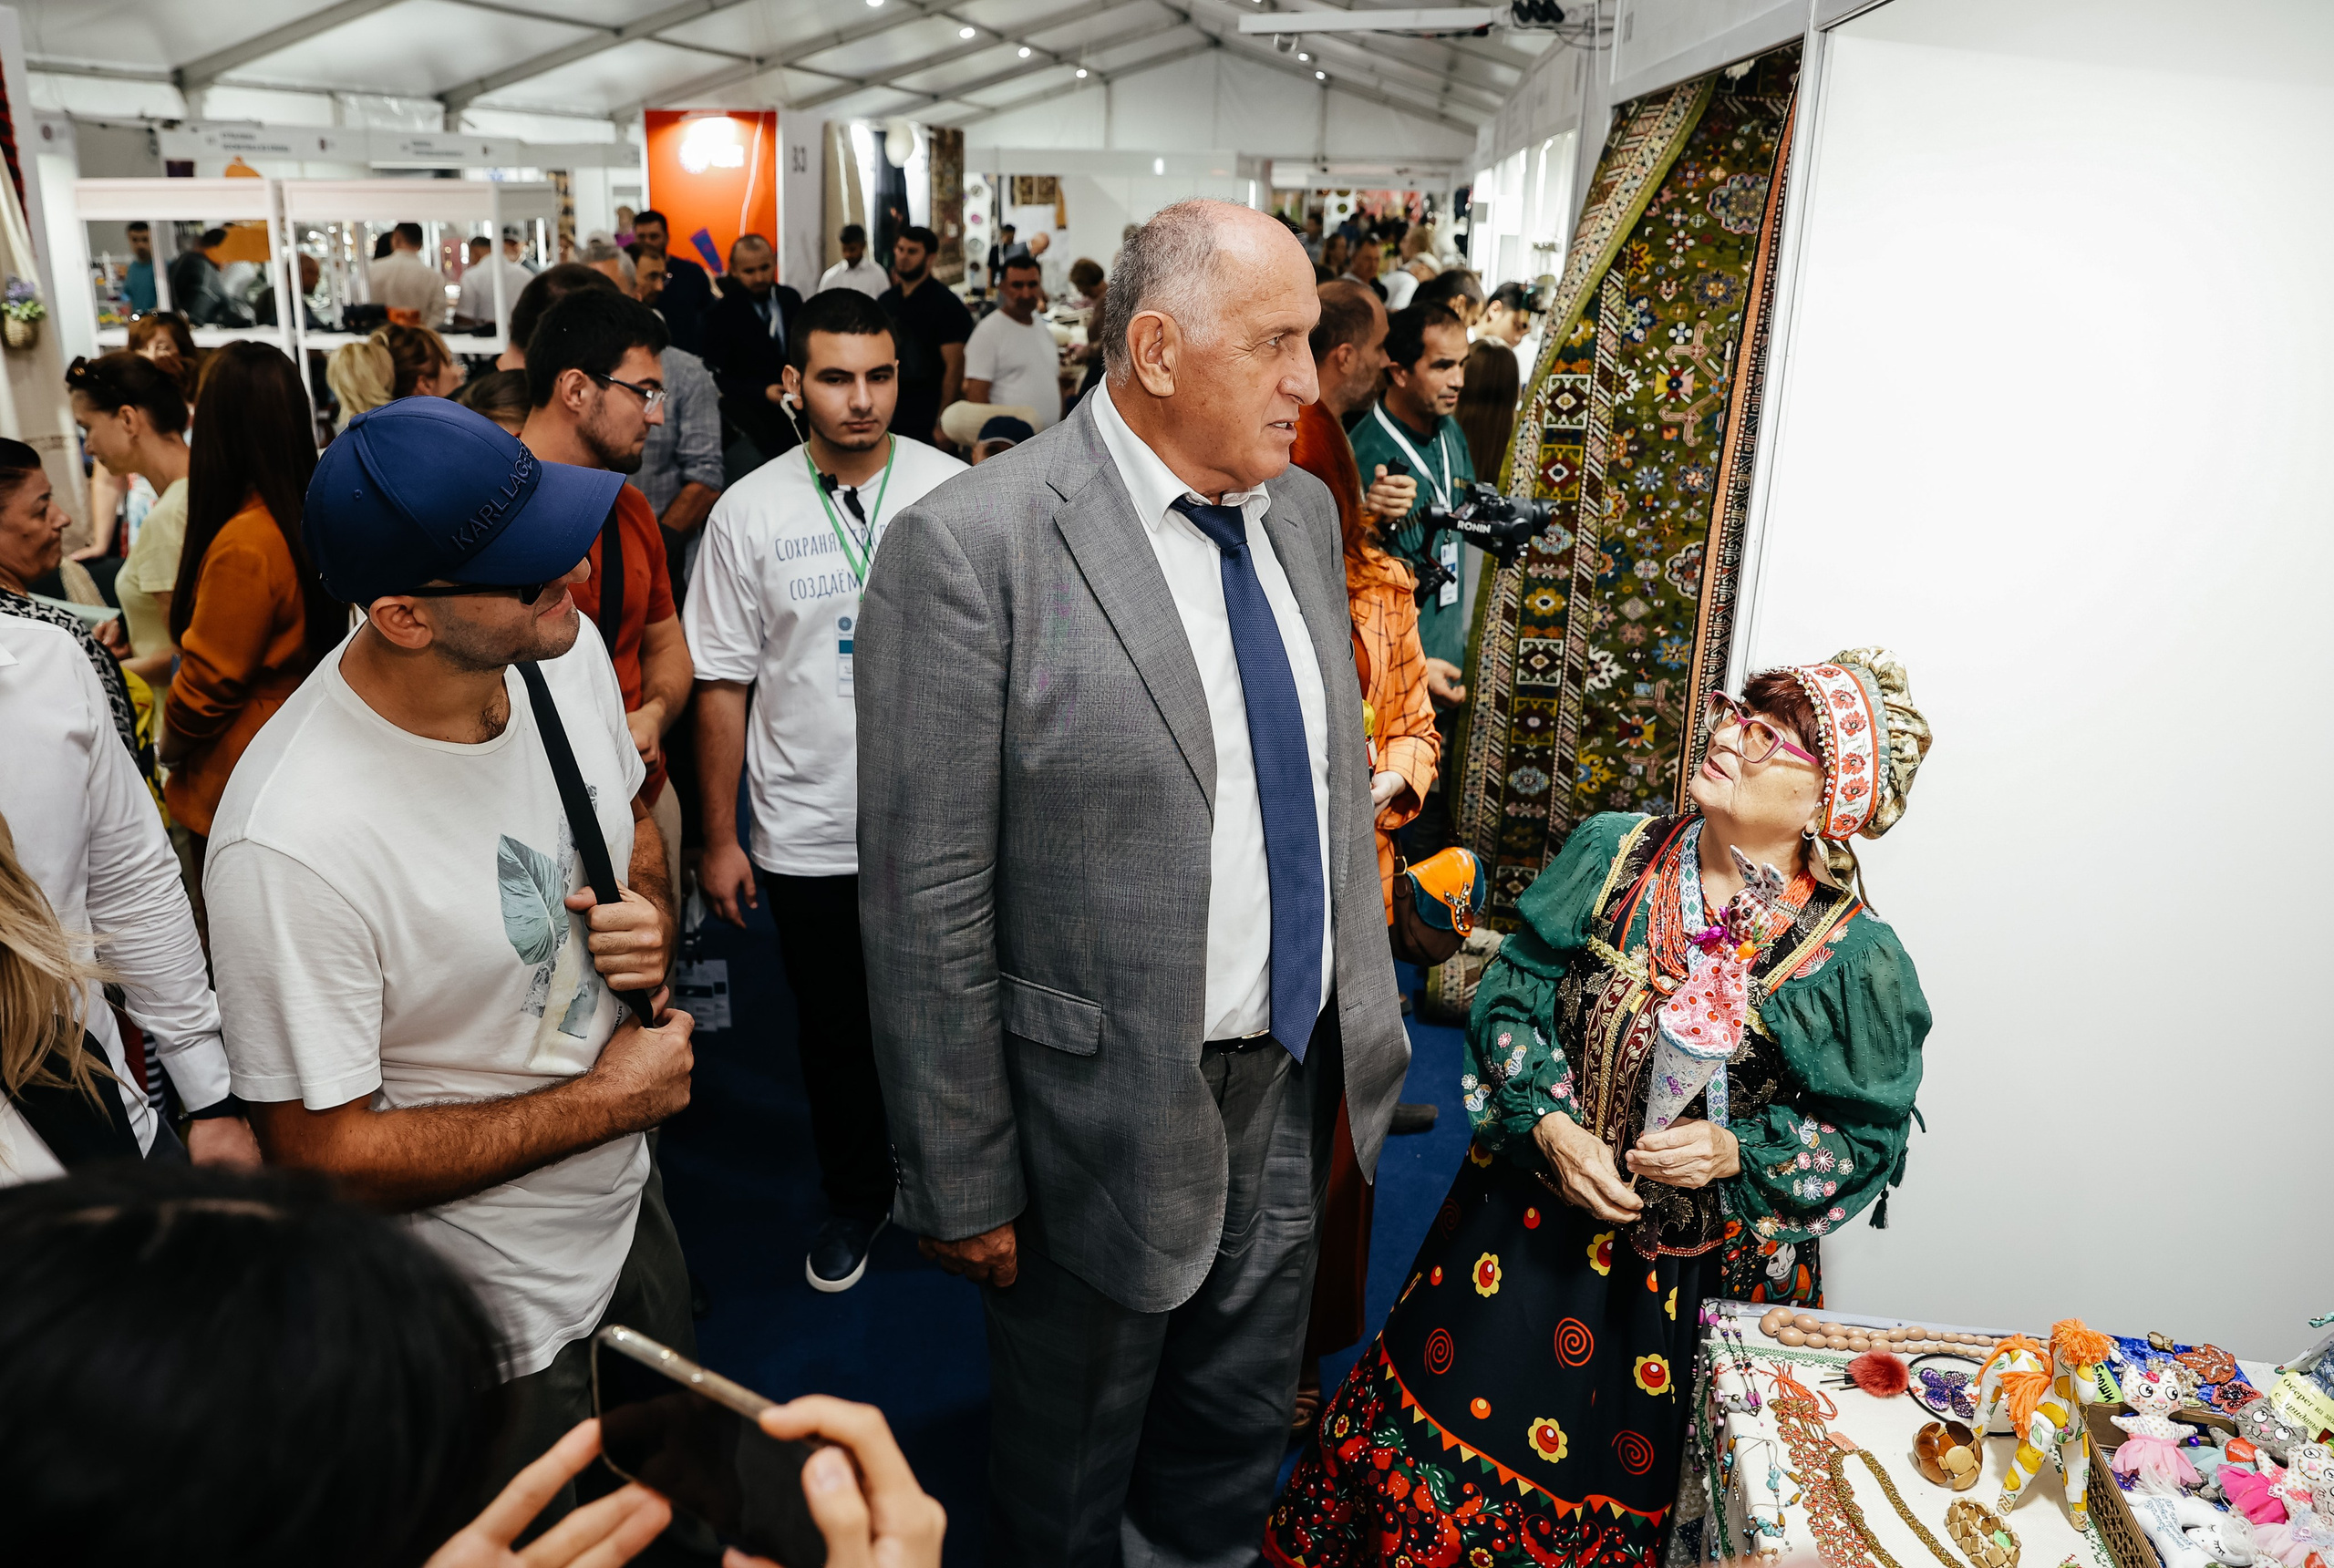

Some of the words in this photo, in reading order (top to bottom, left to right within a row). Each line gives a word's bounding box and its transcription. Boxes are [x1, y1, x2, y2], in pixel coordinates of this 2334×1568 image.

[451, 499, 509, 551] KARL
[500, 443, 535, 500] LAGER
[1457, 520, 1492, 534] RONIN
[2283, 1378, 2314, 1407] Оберег
